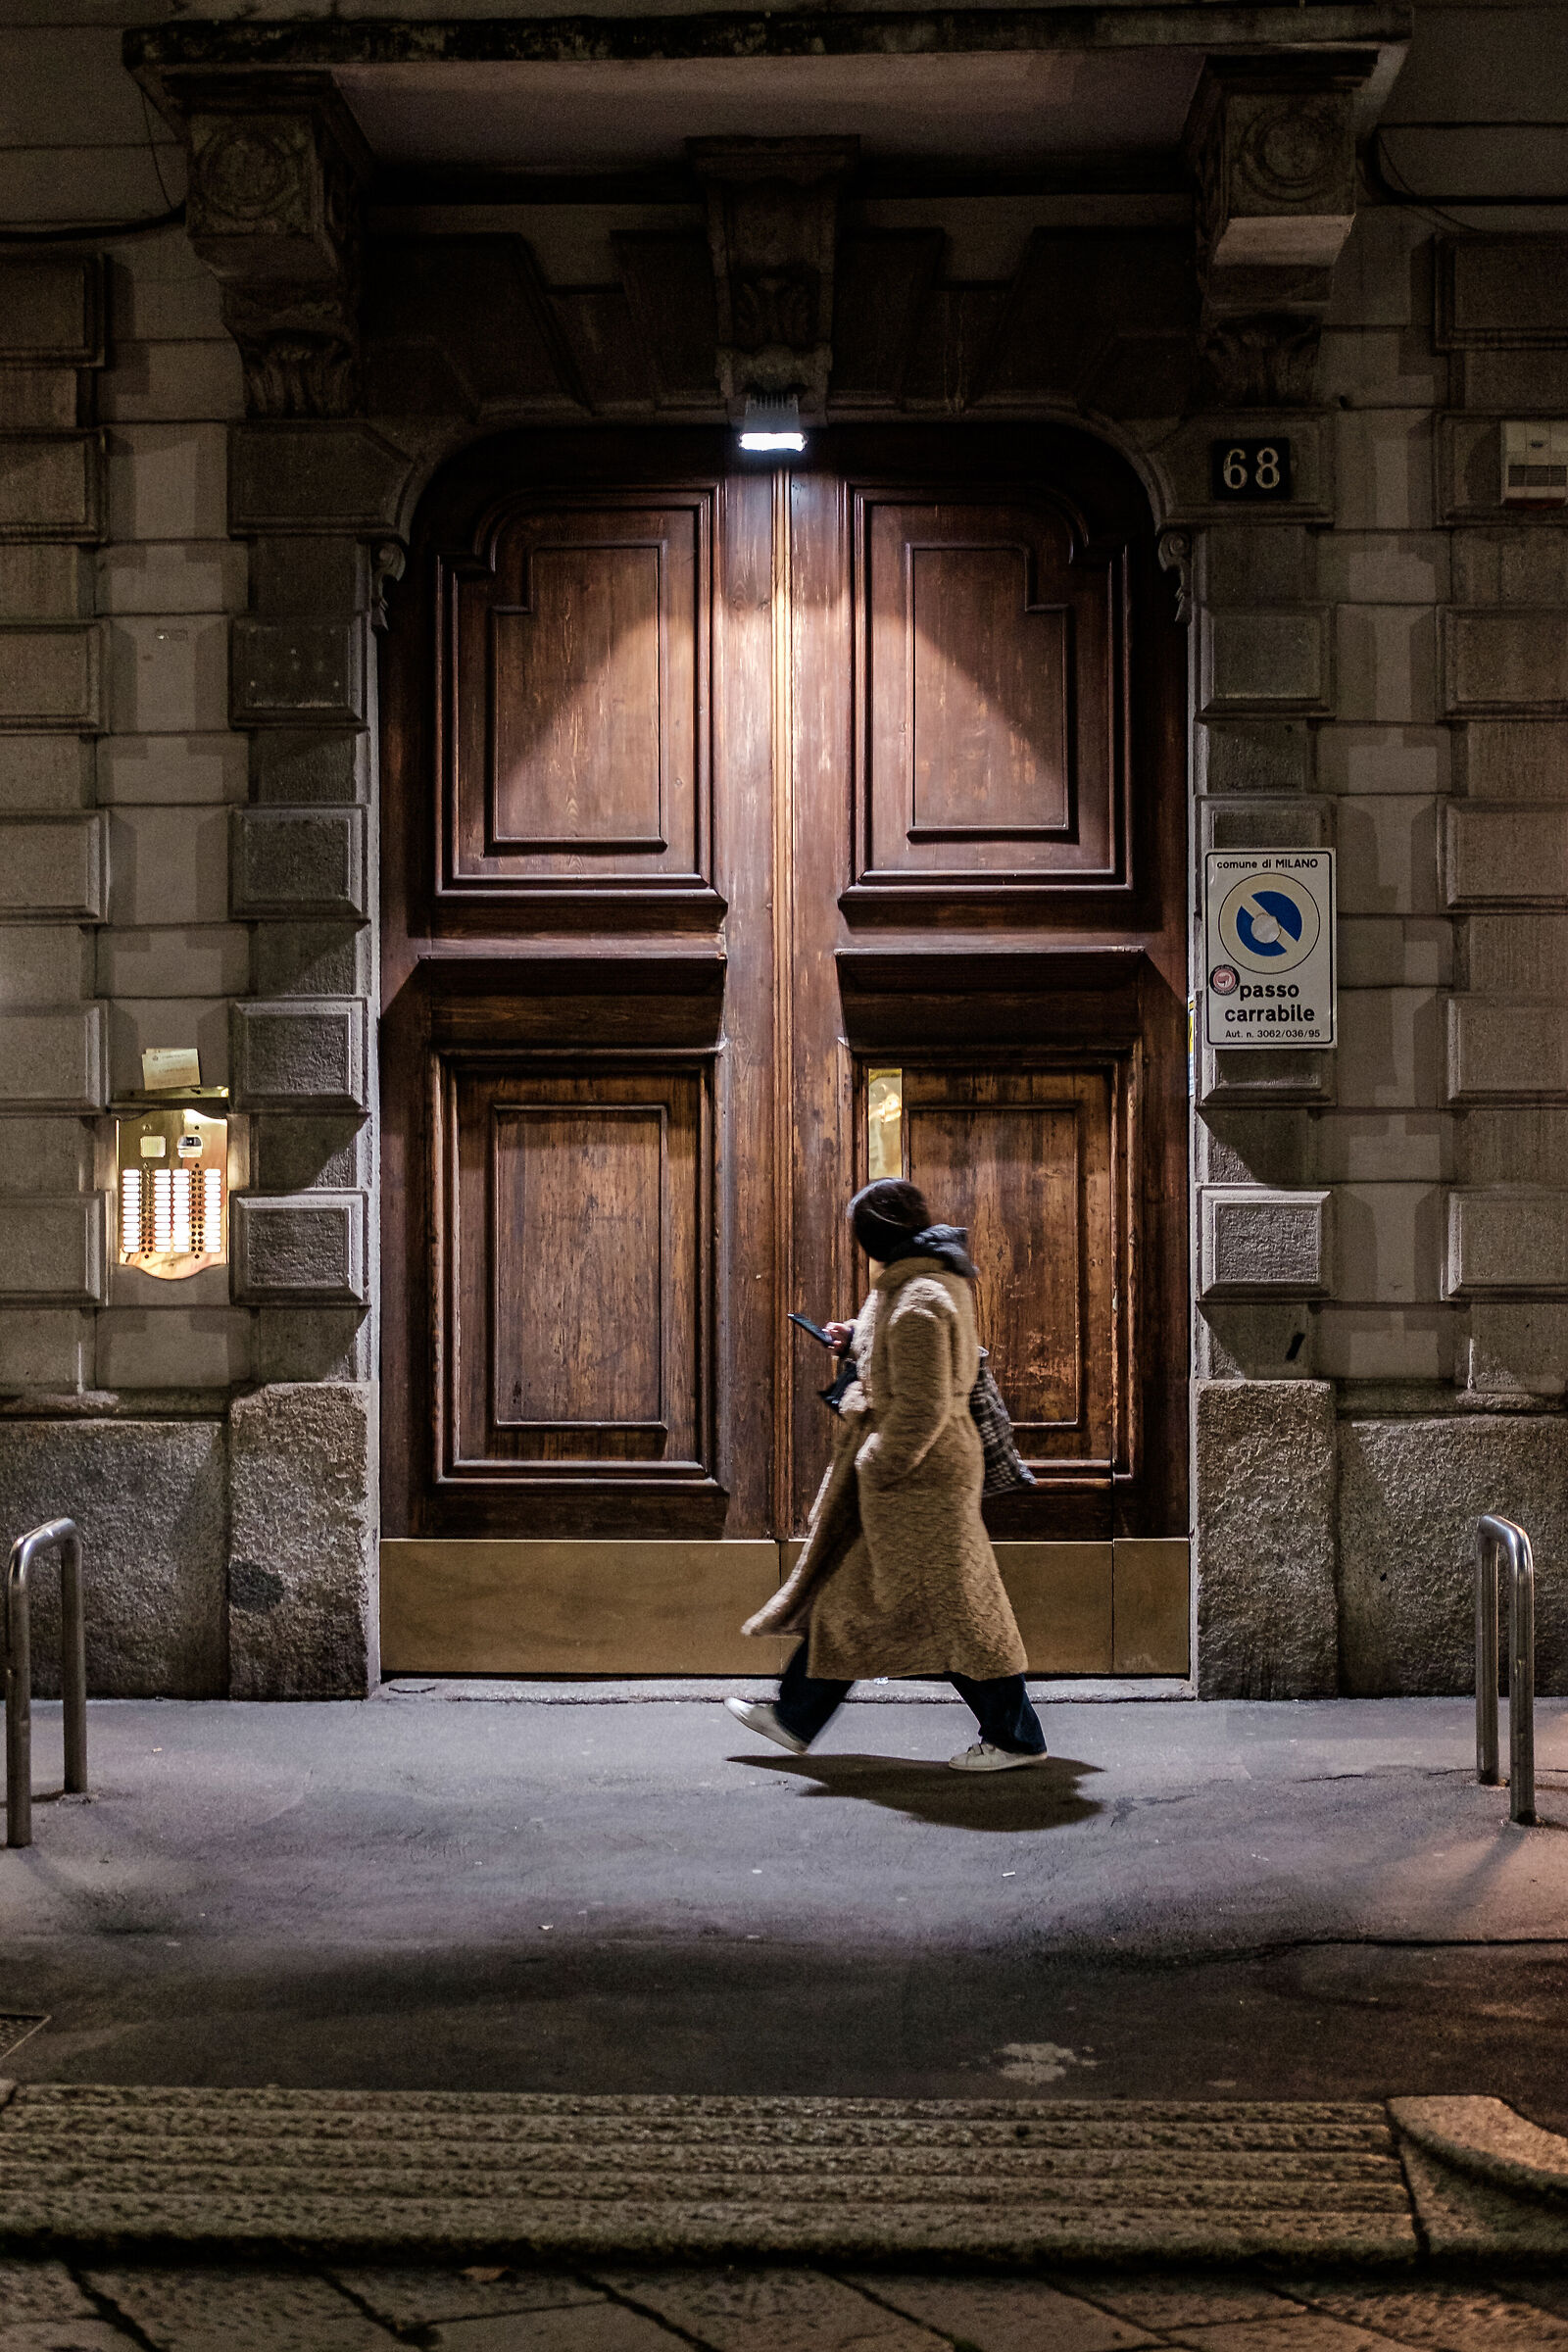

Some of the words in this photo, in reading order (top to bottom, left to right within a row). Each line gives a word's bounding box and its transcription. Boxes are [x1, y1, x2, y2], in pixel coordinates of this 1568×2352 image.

[1223, 447, 1280, 489] 68
[1216, 860, 1257, 869] comune
[1261, 858, 1272, 868] di
[1275, 858, 1318, 868] MILANO
[1239, 984, 1299, 1002] passo
[1225, 1004, 1315, 1022] carrabile
[1256, 1029, 1320, 1038] 3062/036/95
